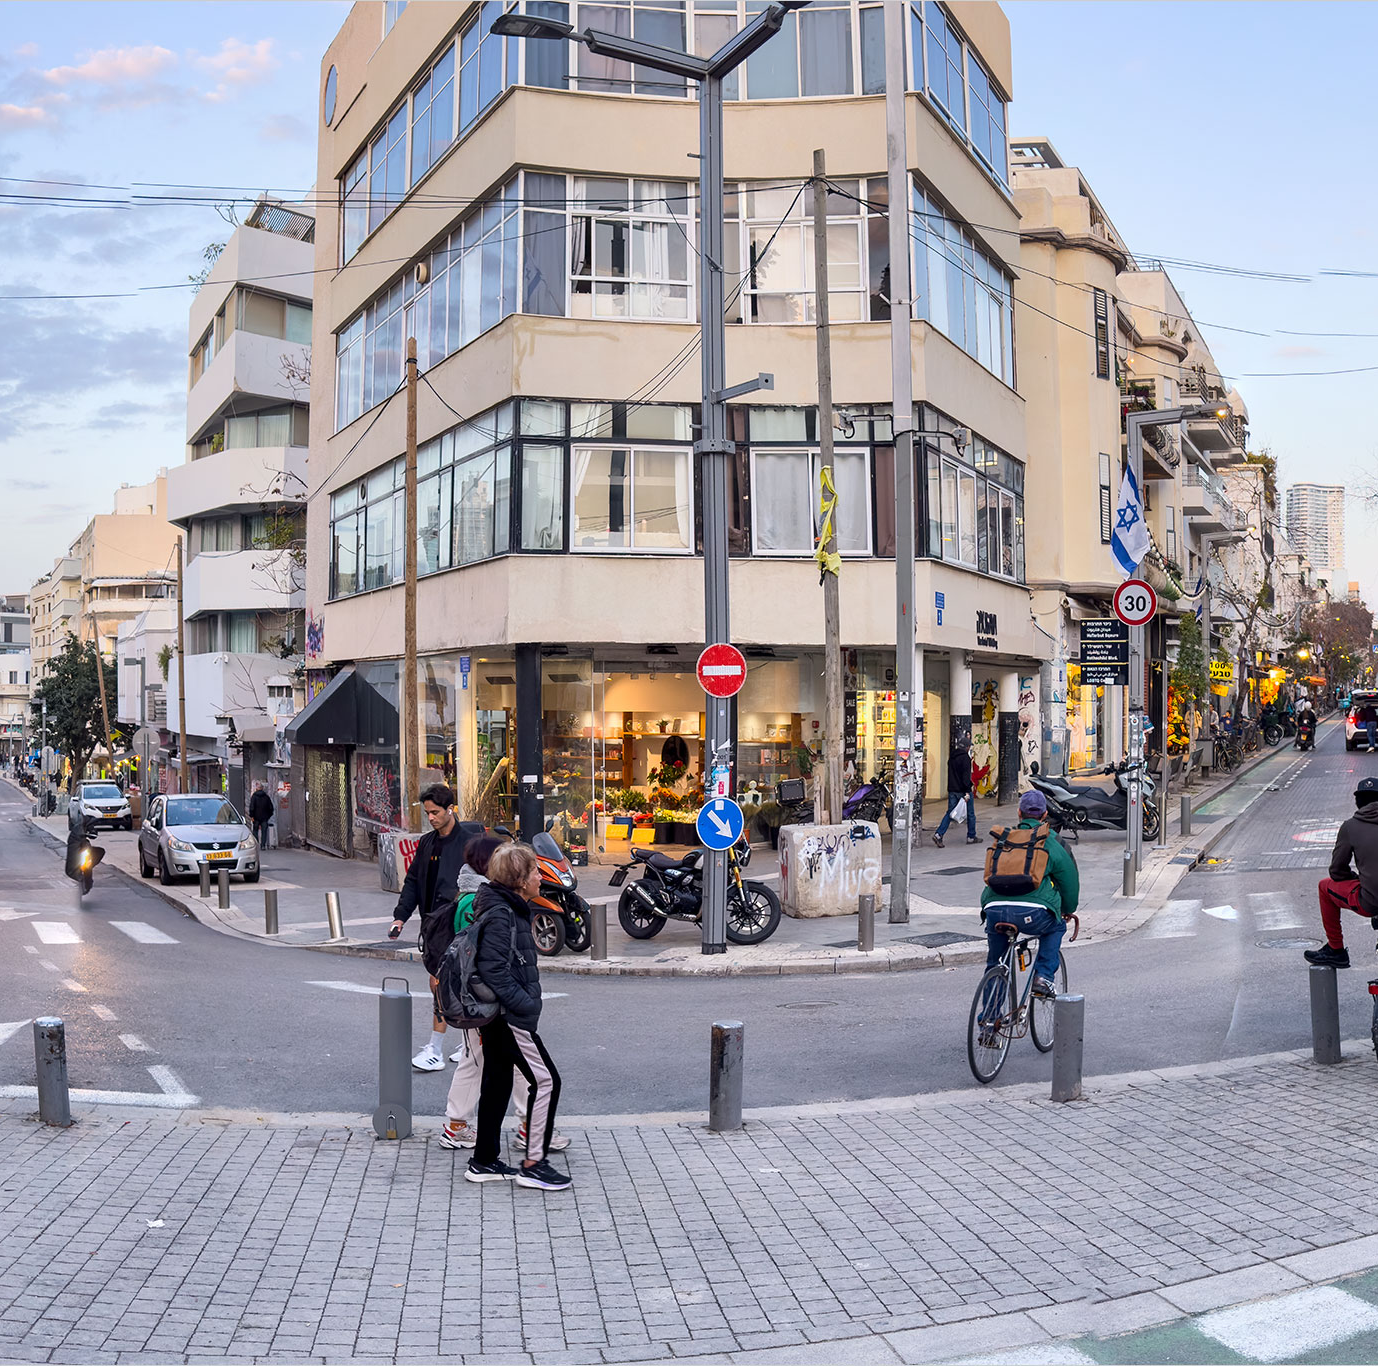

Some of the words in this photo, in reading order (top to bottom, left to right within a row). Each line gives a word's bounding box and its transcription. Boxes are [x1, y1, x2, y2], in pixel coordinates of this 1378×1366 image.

[1124, 596, 1146, 611] 30
[1210, 662, 1233, 670] 100%
[846, 699, 855, 707] SALE
